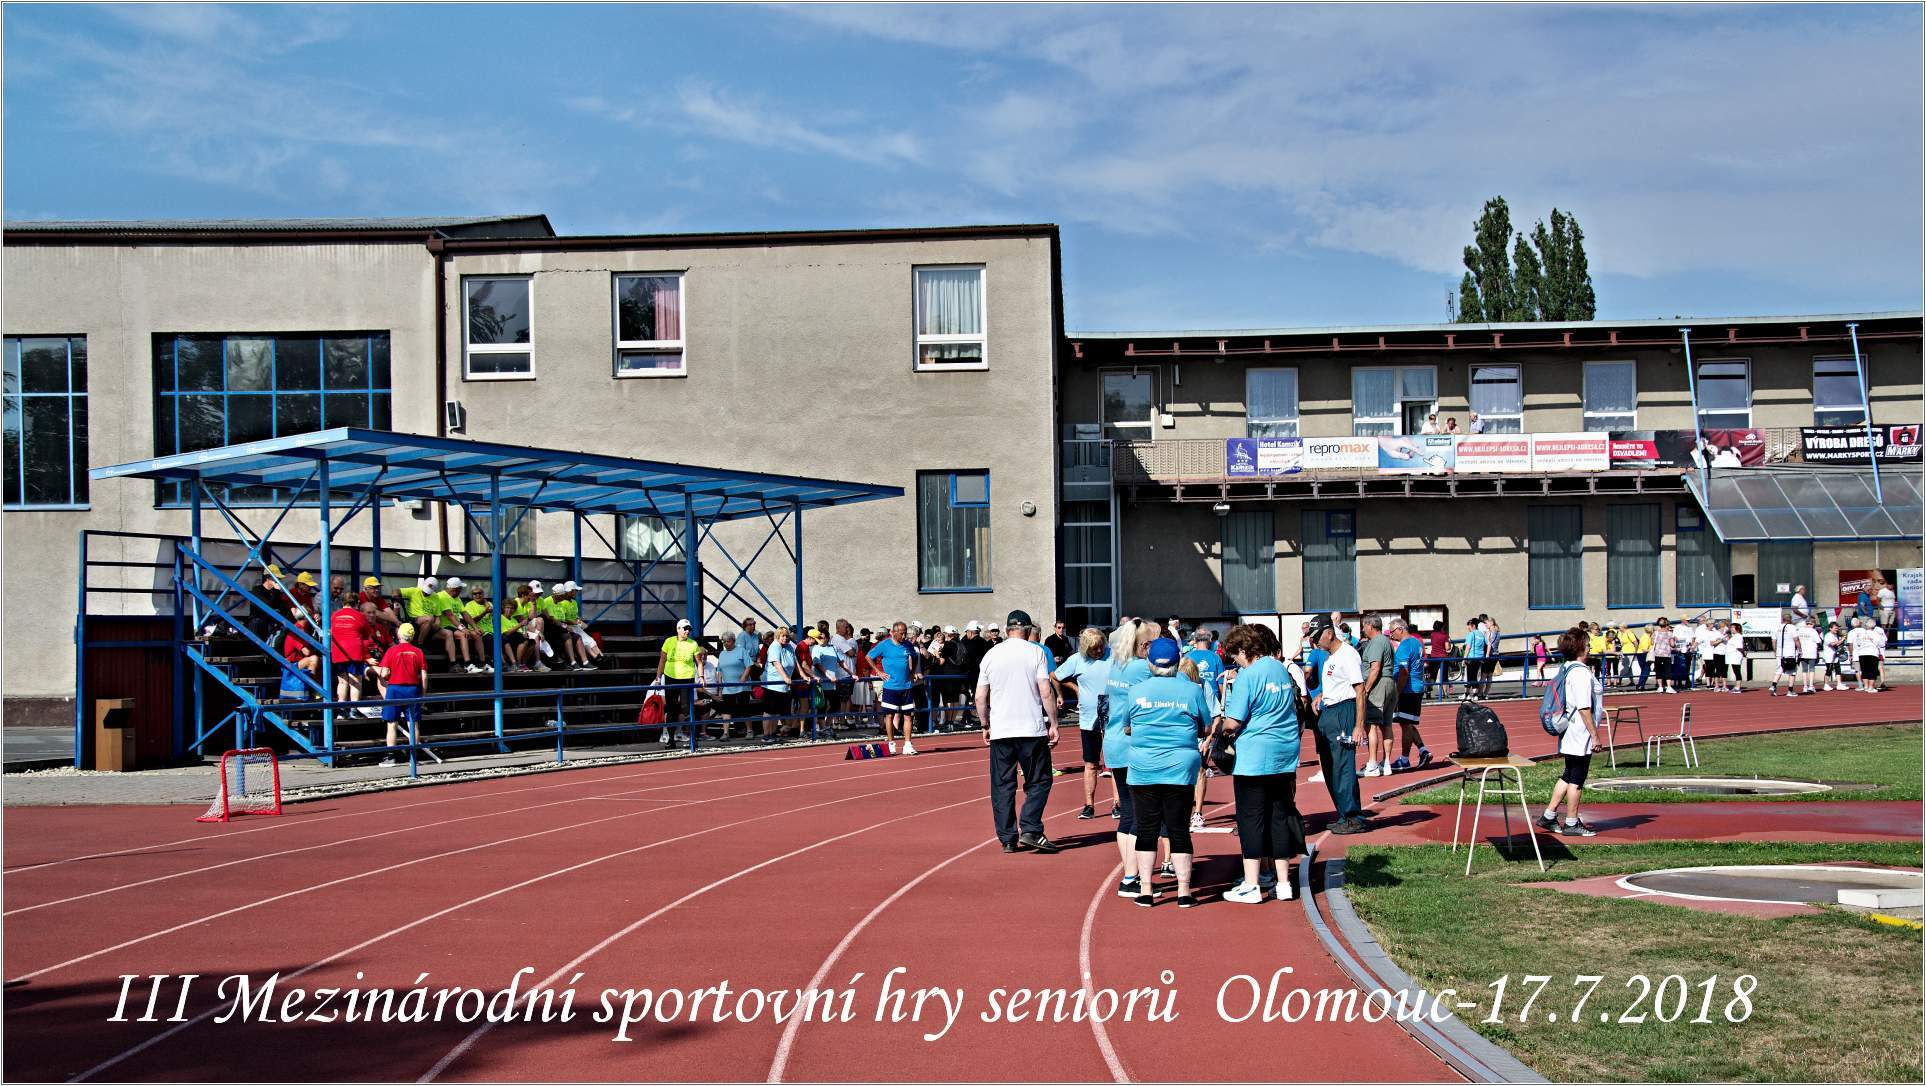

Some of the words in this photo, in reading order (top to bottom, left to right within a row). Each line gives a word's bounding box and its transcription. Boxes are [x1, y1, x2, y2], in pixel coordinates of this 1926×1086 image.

[1805, 435, 1848, 449] VÝROBA
[1309, 443, 1370, 457] repromax
[1886, 445, 1919, 456] MARKY
